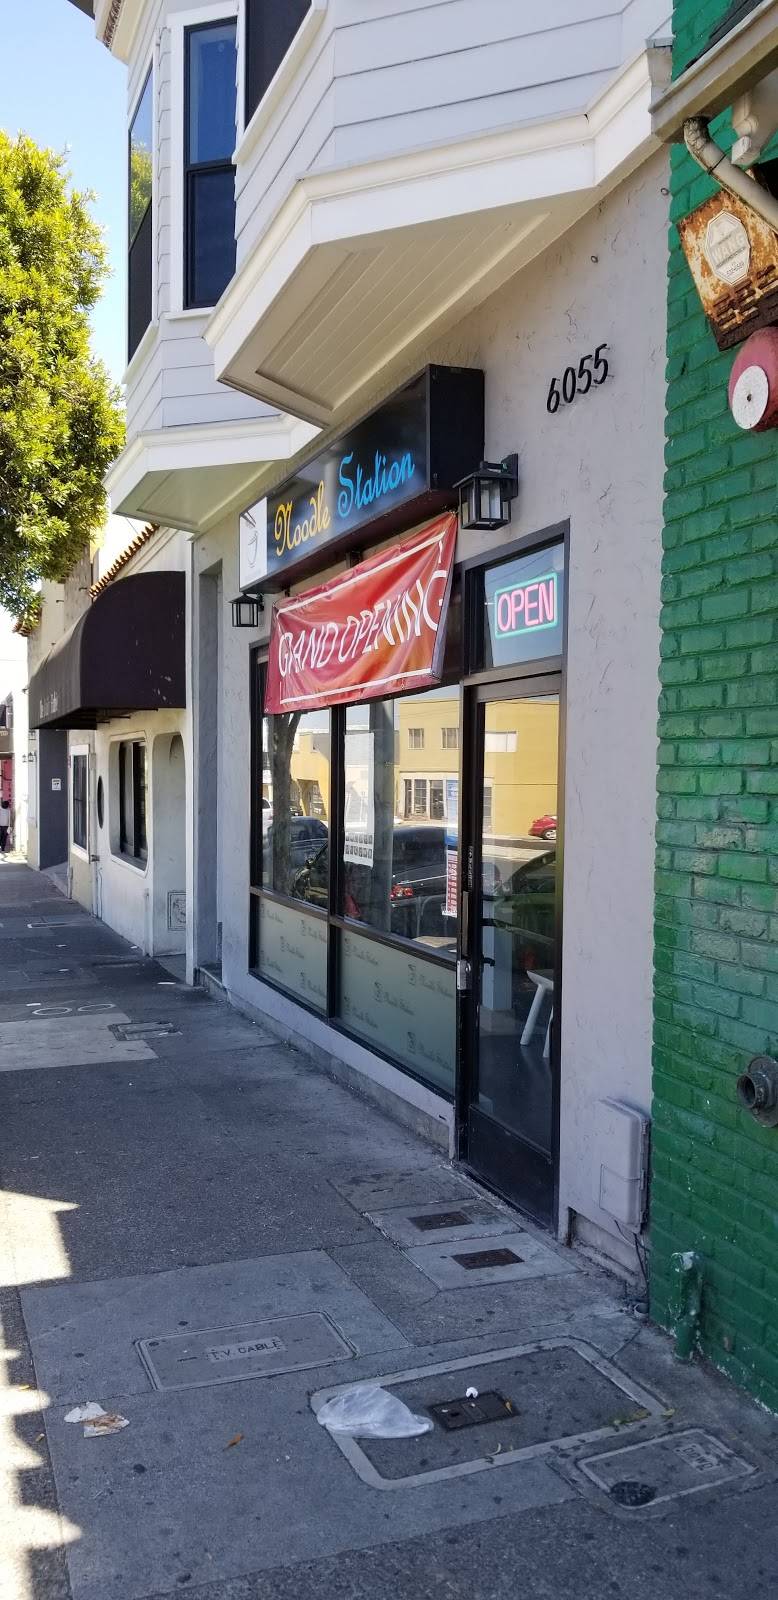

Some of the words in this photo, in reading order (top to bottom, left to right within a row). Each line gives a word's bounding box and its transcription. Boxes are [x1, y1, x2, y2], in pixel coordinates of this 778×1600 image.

[547, 343, 609, 413] 6055
[274, 479, 331, 556] Noodle
[337, 449, 416, 518] Station
[338, 569, 447, 663] OPENING
[497, 579, 554, 632] OPEN
[238, 1339, 281, 1354] CABLE
